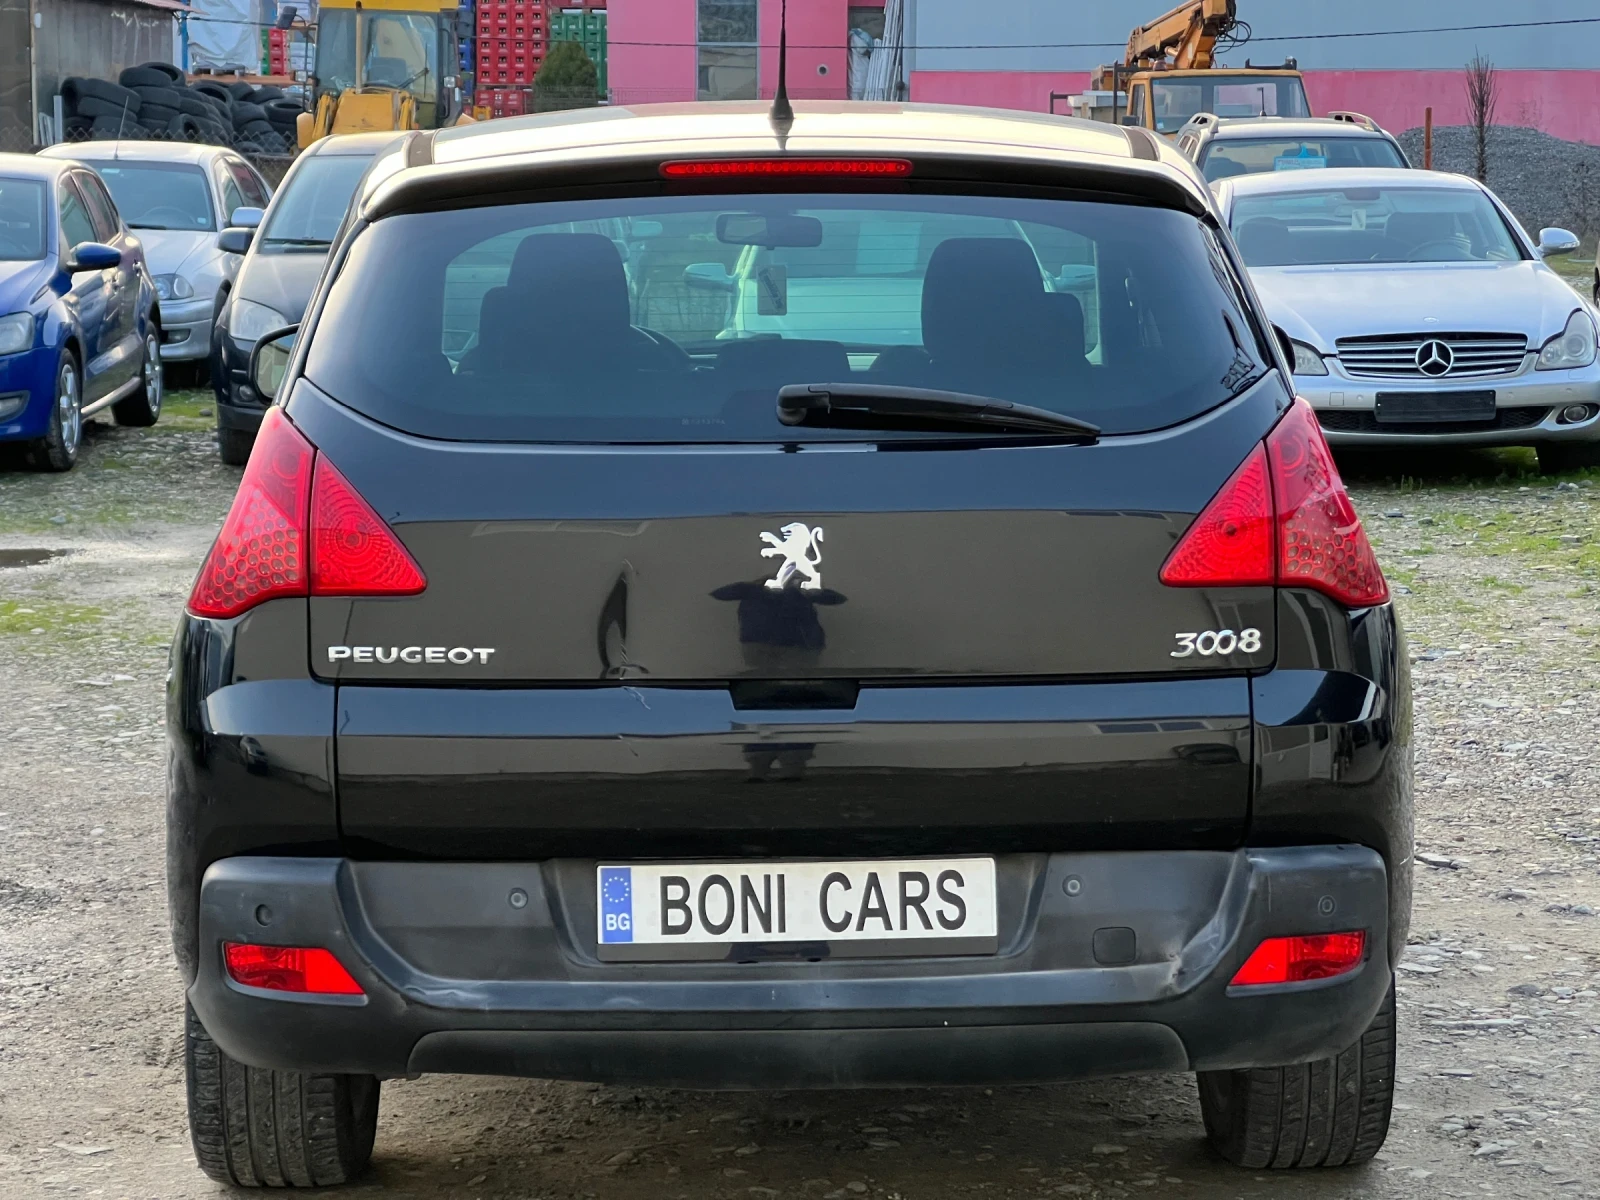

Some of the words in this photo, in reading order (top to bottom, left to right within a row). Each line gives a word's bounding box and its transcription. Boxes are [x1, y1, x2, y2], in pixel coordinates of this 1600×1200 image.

[327, 645, 496, 665] PEUGEOT
[1169, 627, 1262, 658] 3008
[659, 873, 787, 936] BONI
[819, 869, 967, 933] CARS
[605, 912, 631, 931] BG
